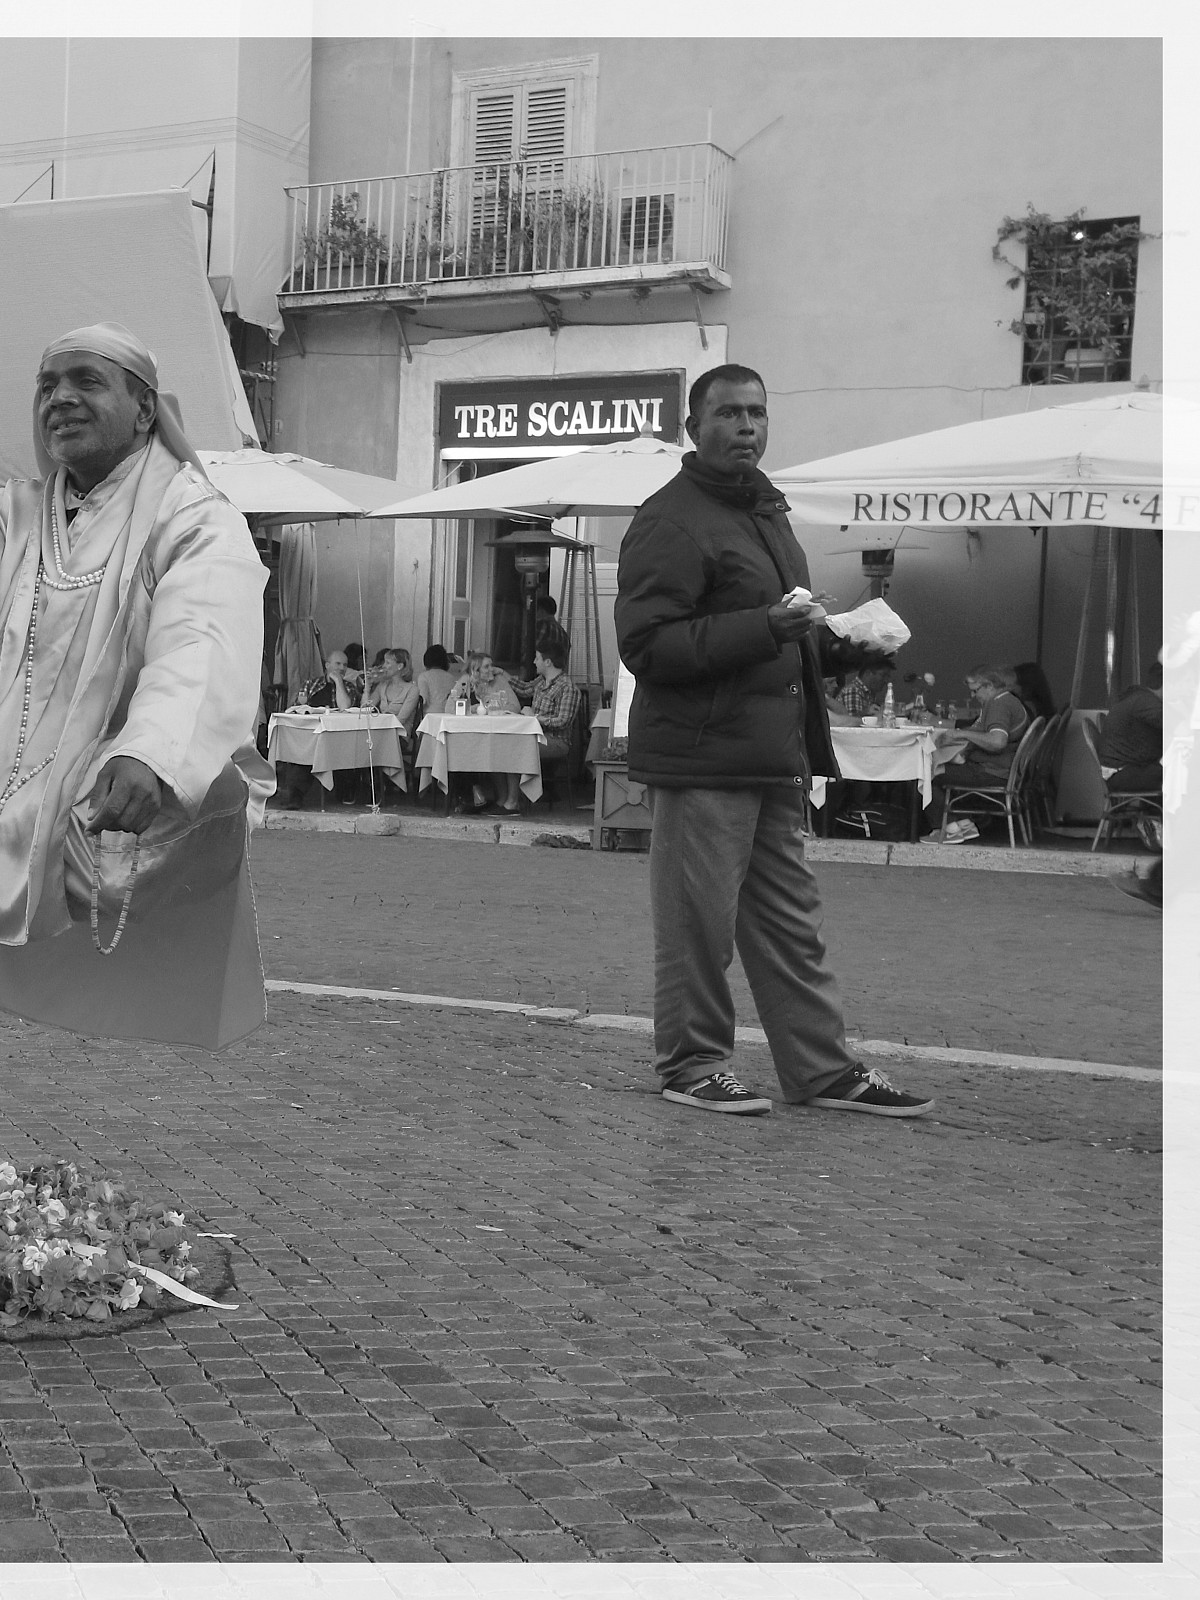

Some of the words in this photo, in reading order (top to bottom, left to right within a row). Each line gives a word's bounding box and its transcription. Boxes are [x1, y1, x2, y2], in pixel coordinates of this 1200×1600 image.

[455, 404, 518, 438] TRE
[527, 398, 663, 438] SCALINI
[852, 491, 1108, 522] RISTORANTE
